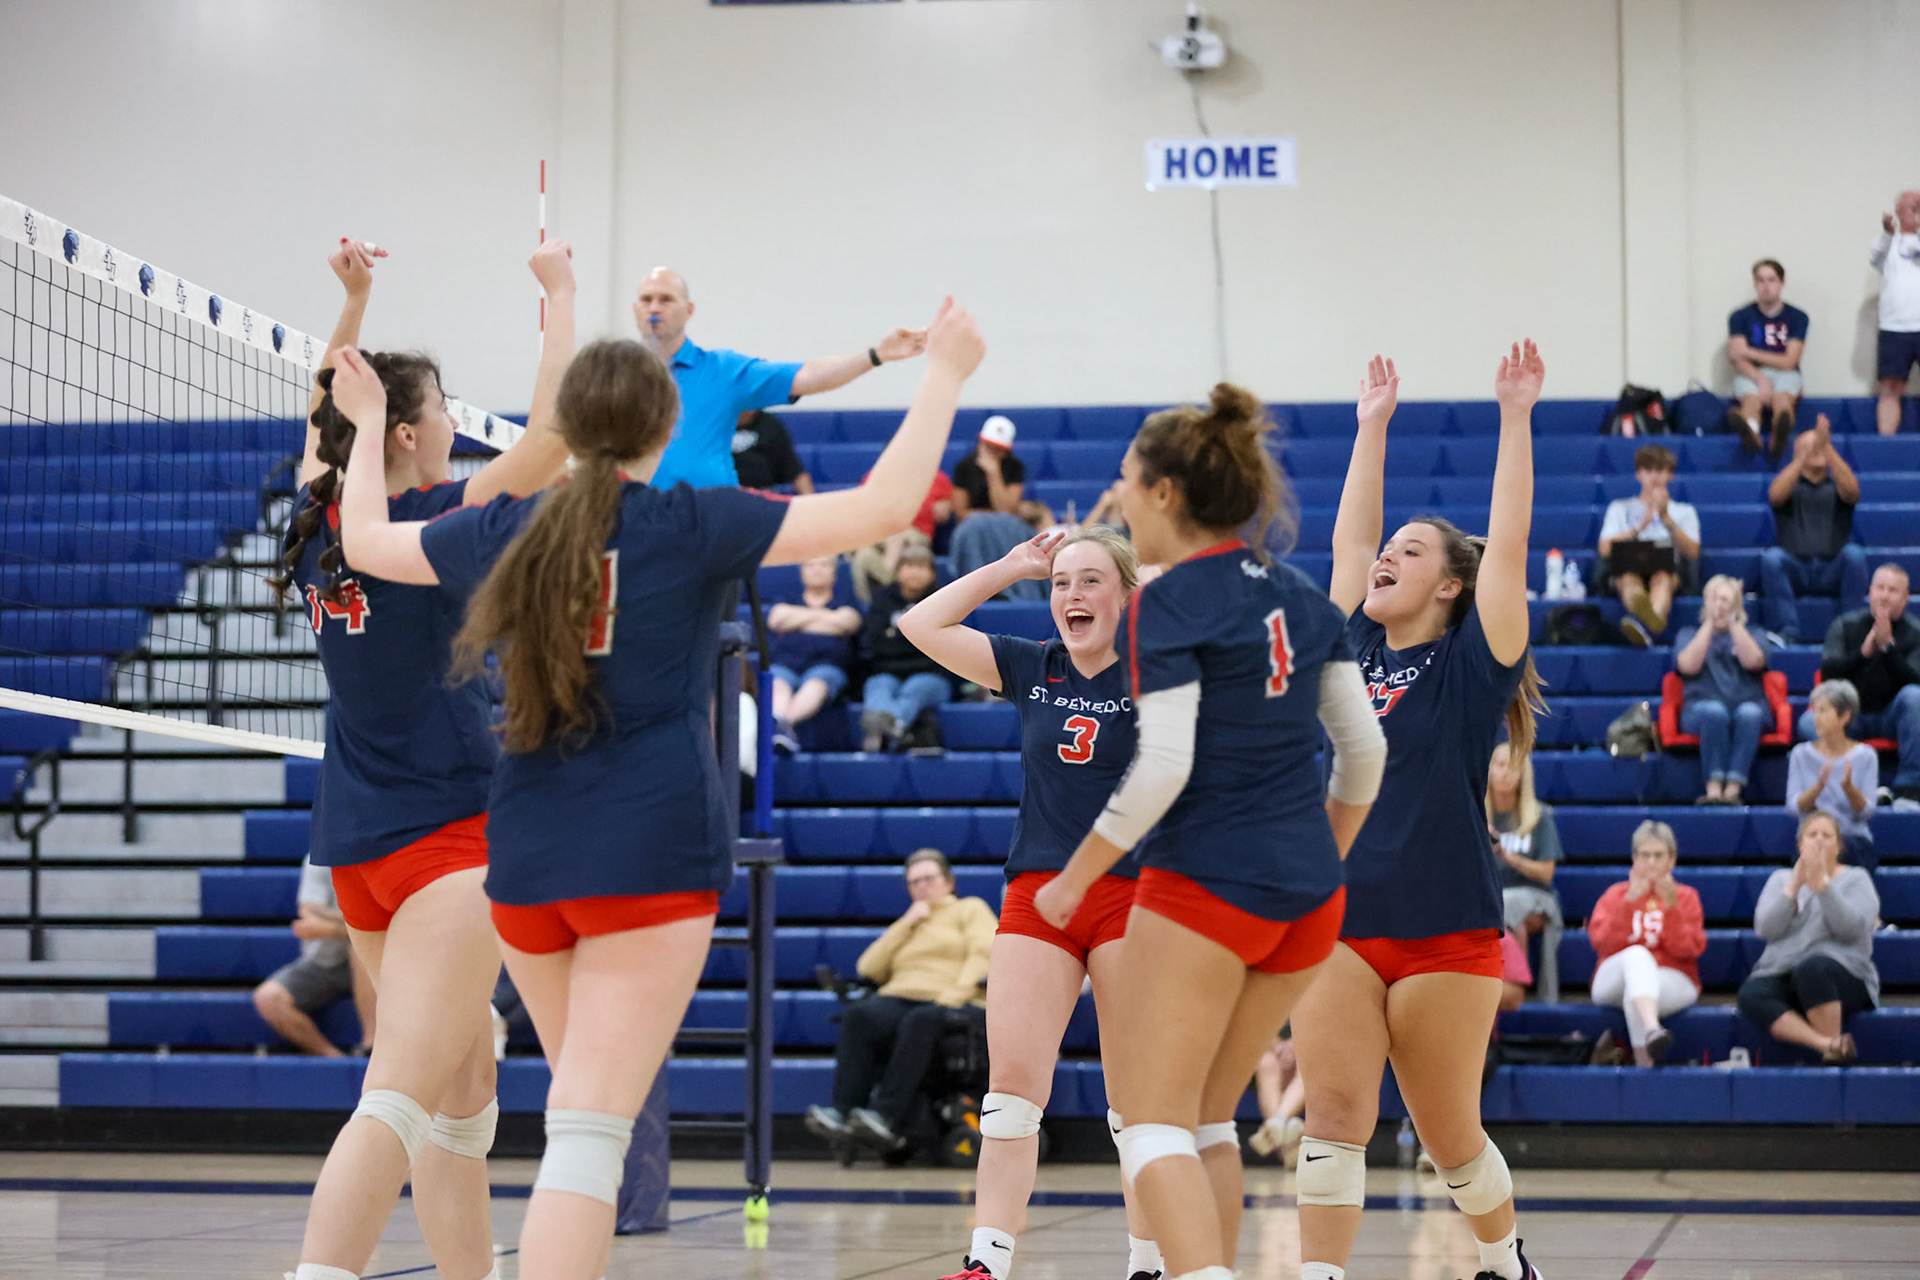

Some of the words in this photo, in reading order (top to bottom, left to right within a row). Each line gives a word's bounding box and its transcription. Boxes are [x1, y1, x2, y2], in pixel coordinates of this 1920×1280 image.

[1165, 146, 1277, 178] HOME
[304, 577, 372, 635] 14
[1263, 607, 1295, 698] 1
[1028, 685, 1049, 703] ST.
[1056, 713, 1101, 765] 3
